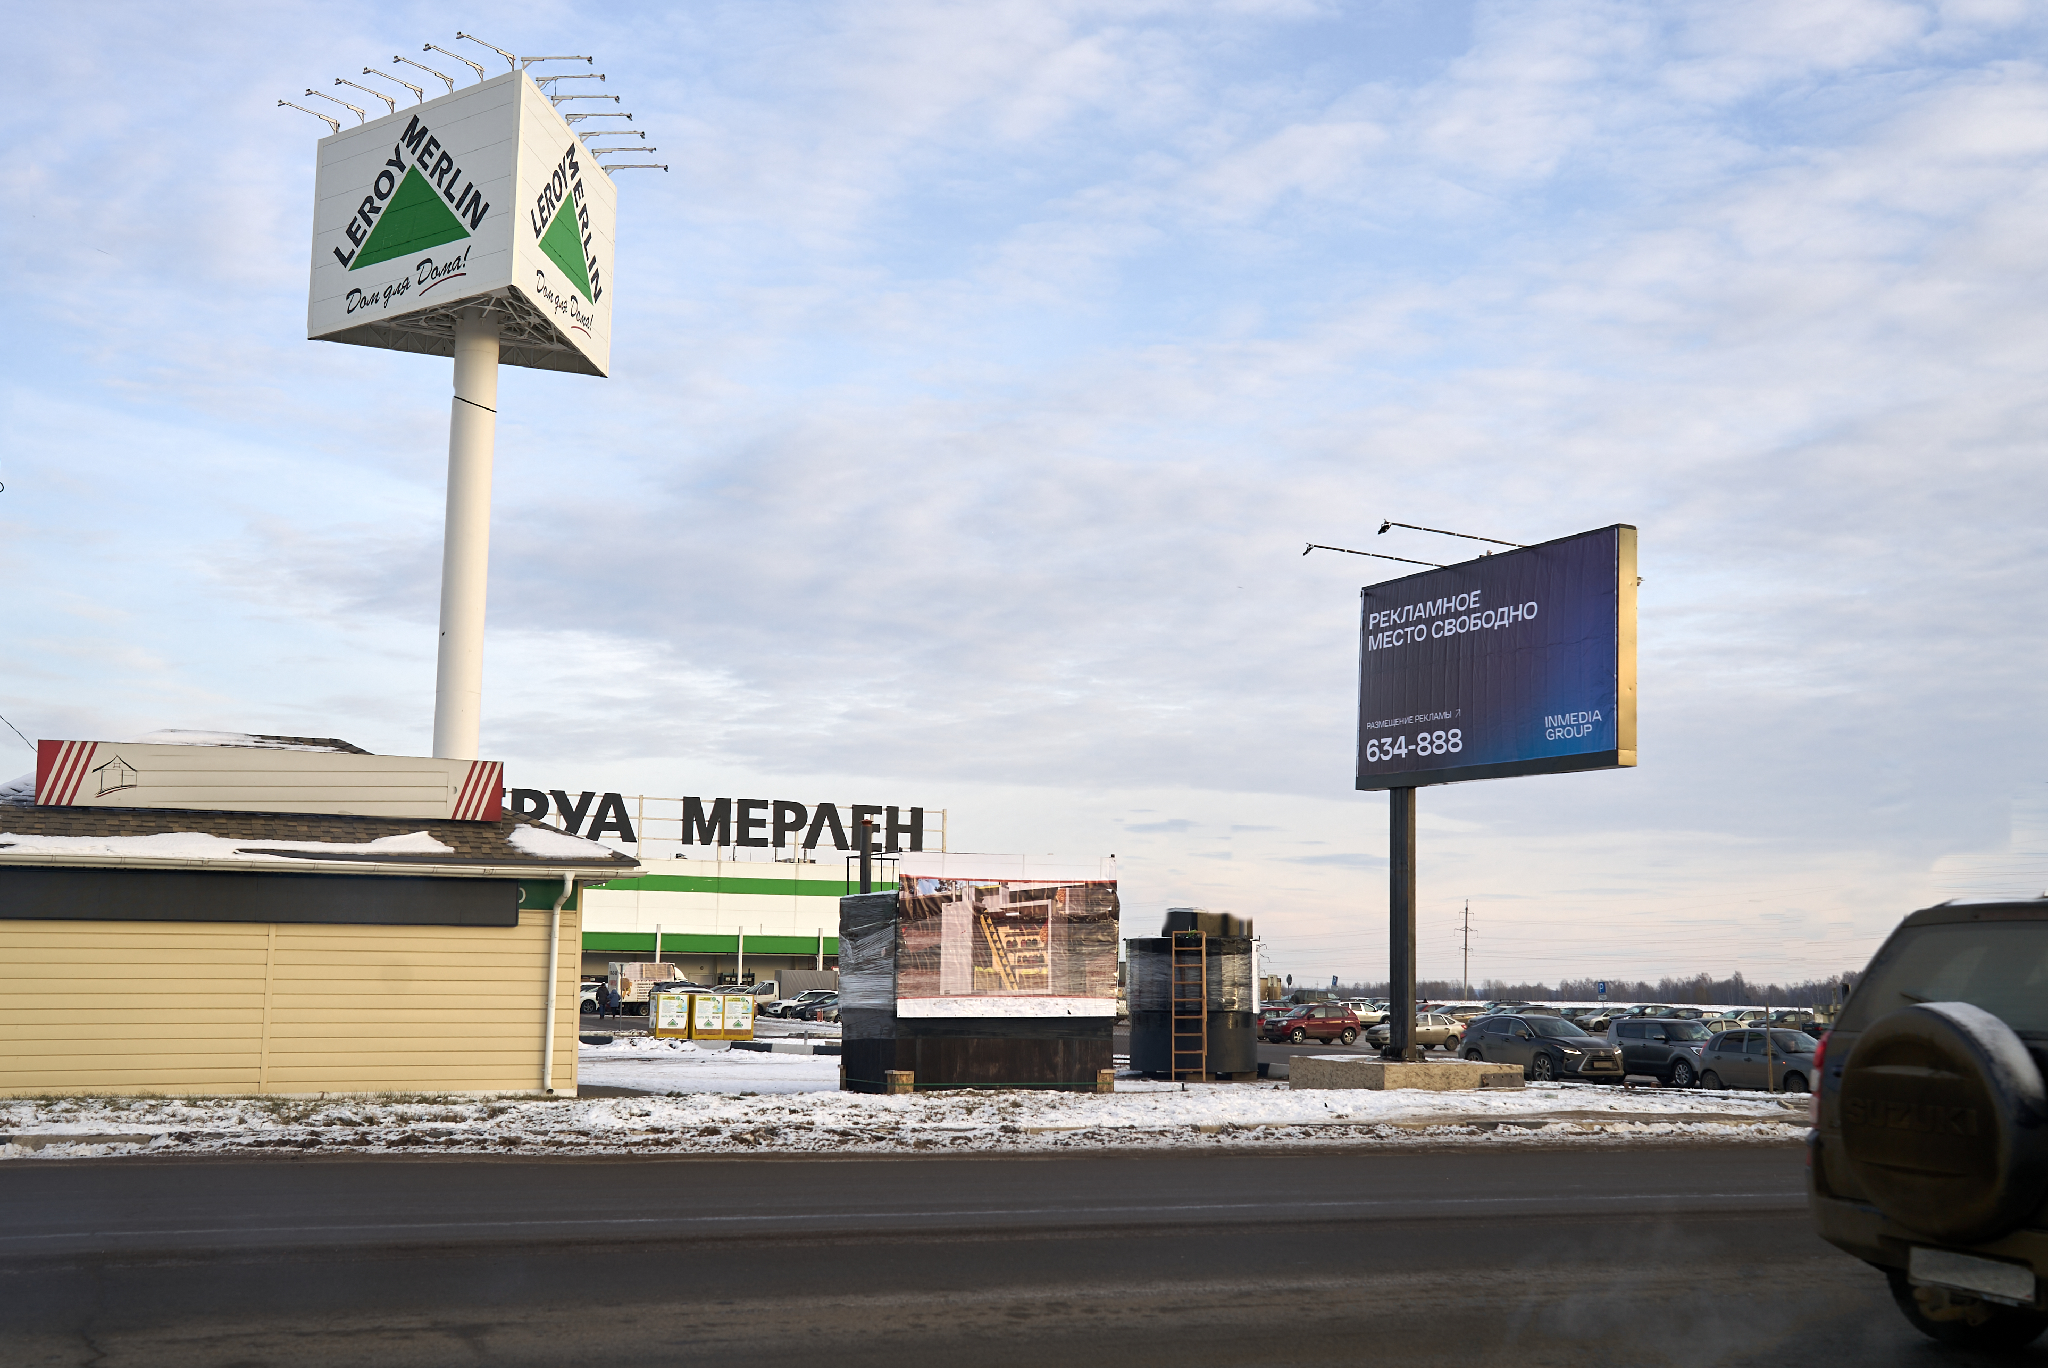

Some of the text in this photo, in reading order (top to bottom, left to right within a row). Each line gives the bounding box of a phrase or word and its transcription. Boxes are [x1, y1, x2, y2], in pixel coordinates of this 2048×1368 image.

[333, 114, 490, 268] LEROY MERLIN
[531, 142, 602, 303] LEROY MERLIN
[346, 245, 471, 314] Дом для Дома!
[1368, 601, 1538, 651] МЕСТО СВОБОДНО
[1369, 590, 1481, 630] РЕКЛАМНОЕ
[1366, 710, 1452, 730] РАЗМЕЩЕНИЕ РЕКЛАМЫ
[1545, 709, 1603, 728] INMEDIA
[1545, 724, 1593, 740] GROUP
[1366, 728, 1463, 762] 634-888
[502, 787, 924, 852] РУА МЕРЛЕН
[1845, 1097, 1978, 1137] SUZUKI
